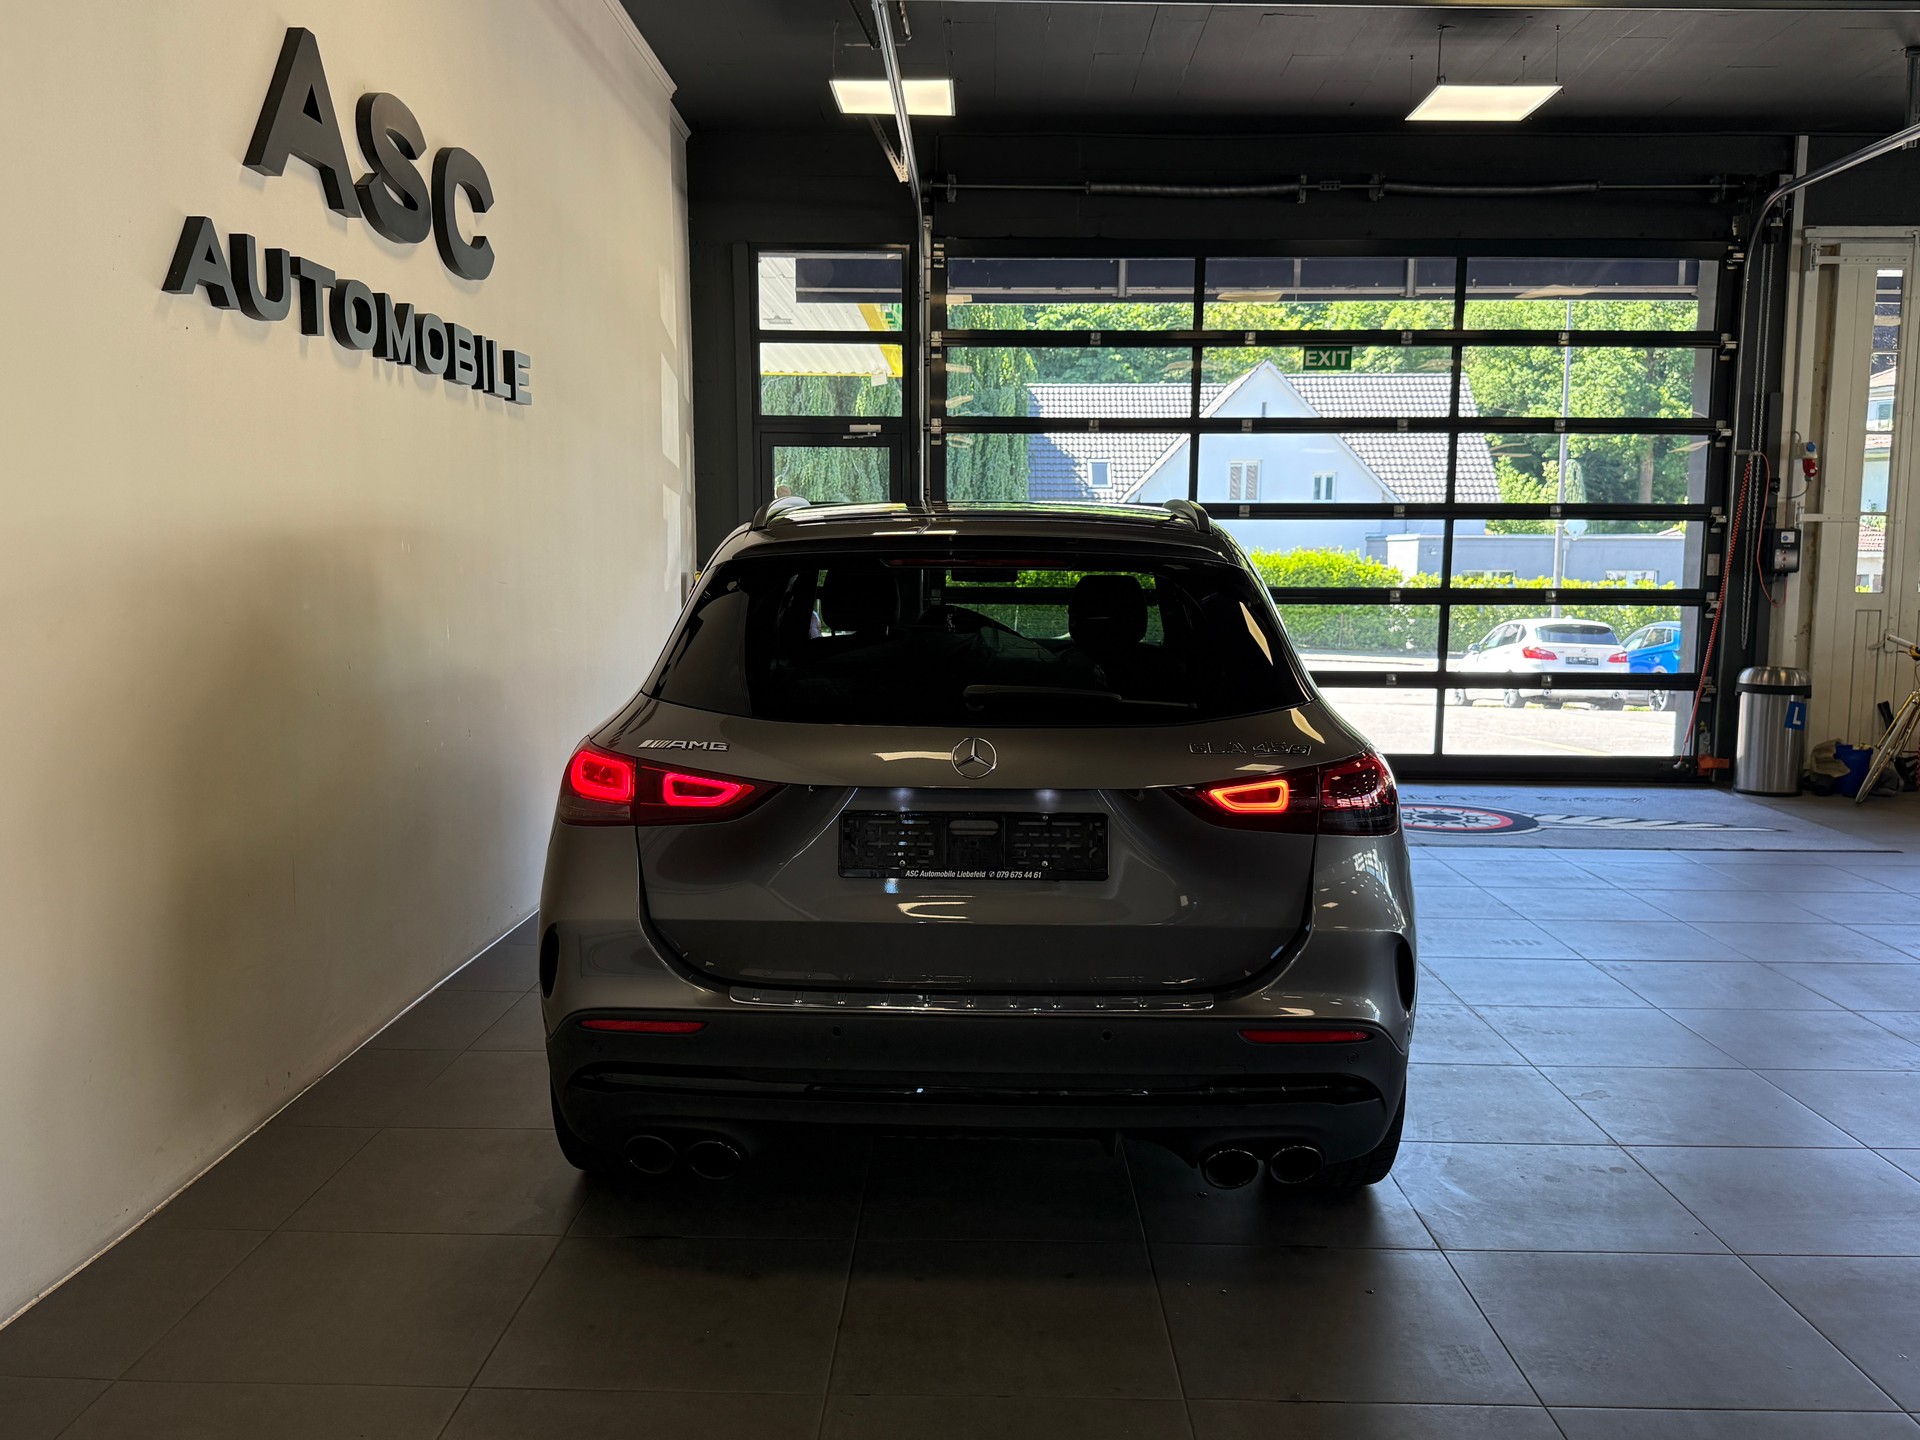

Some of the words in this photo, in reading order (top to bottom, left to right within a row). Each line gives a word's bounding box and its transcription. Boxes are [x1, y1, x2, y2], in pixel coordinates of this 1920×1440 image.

[243, 27, 494, 280] ASC
[161, 216, 531, 405] AUTOMOBILE
[1305, 350, 1350, 367] EXIT
[1792, 706, 1801, 725] L
[665, 740, 728, 751] AMG
[1189, 742, 1247, 754] GLA
[919, 870, 956, 878] Automobile
[956, 870, 986, 878] Liebefeld
